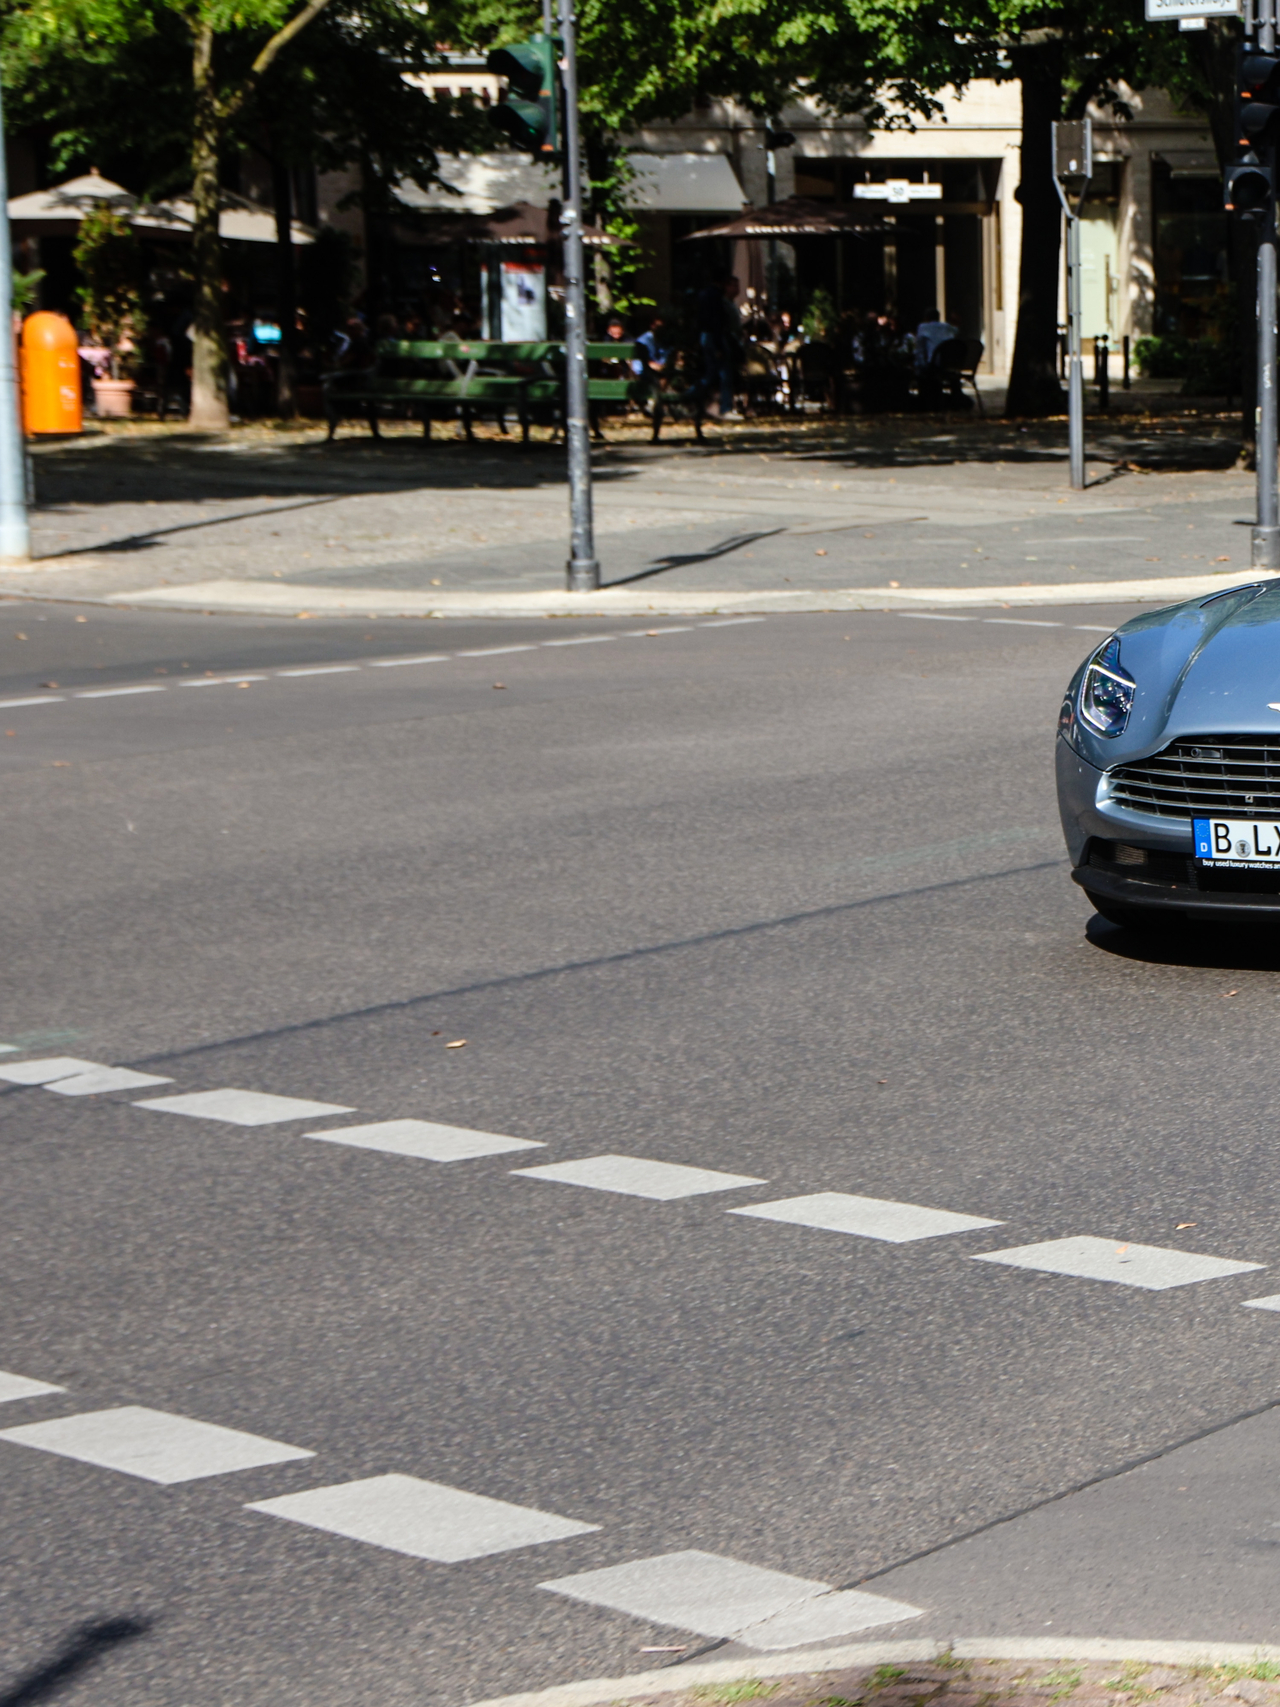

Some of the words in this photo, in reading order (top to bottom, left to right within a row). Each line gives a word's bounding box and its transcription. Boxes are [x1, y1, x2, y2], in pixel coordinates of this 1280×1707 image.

[1213, 823, 1232, 853] B
[1200, 842, 1208, 852] D
[1202, 859, 1214, 867] buy
[1229, 860, 1248, 869] luxury
